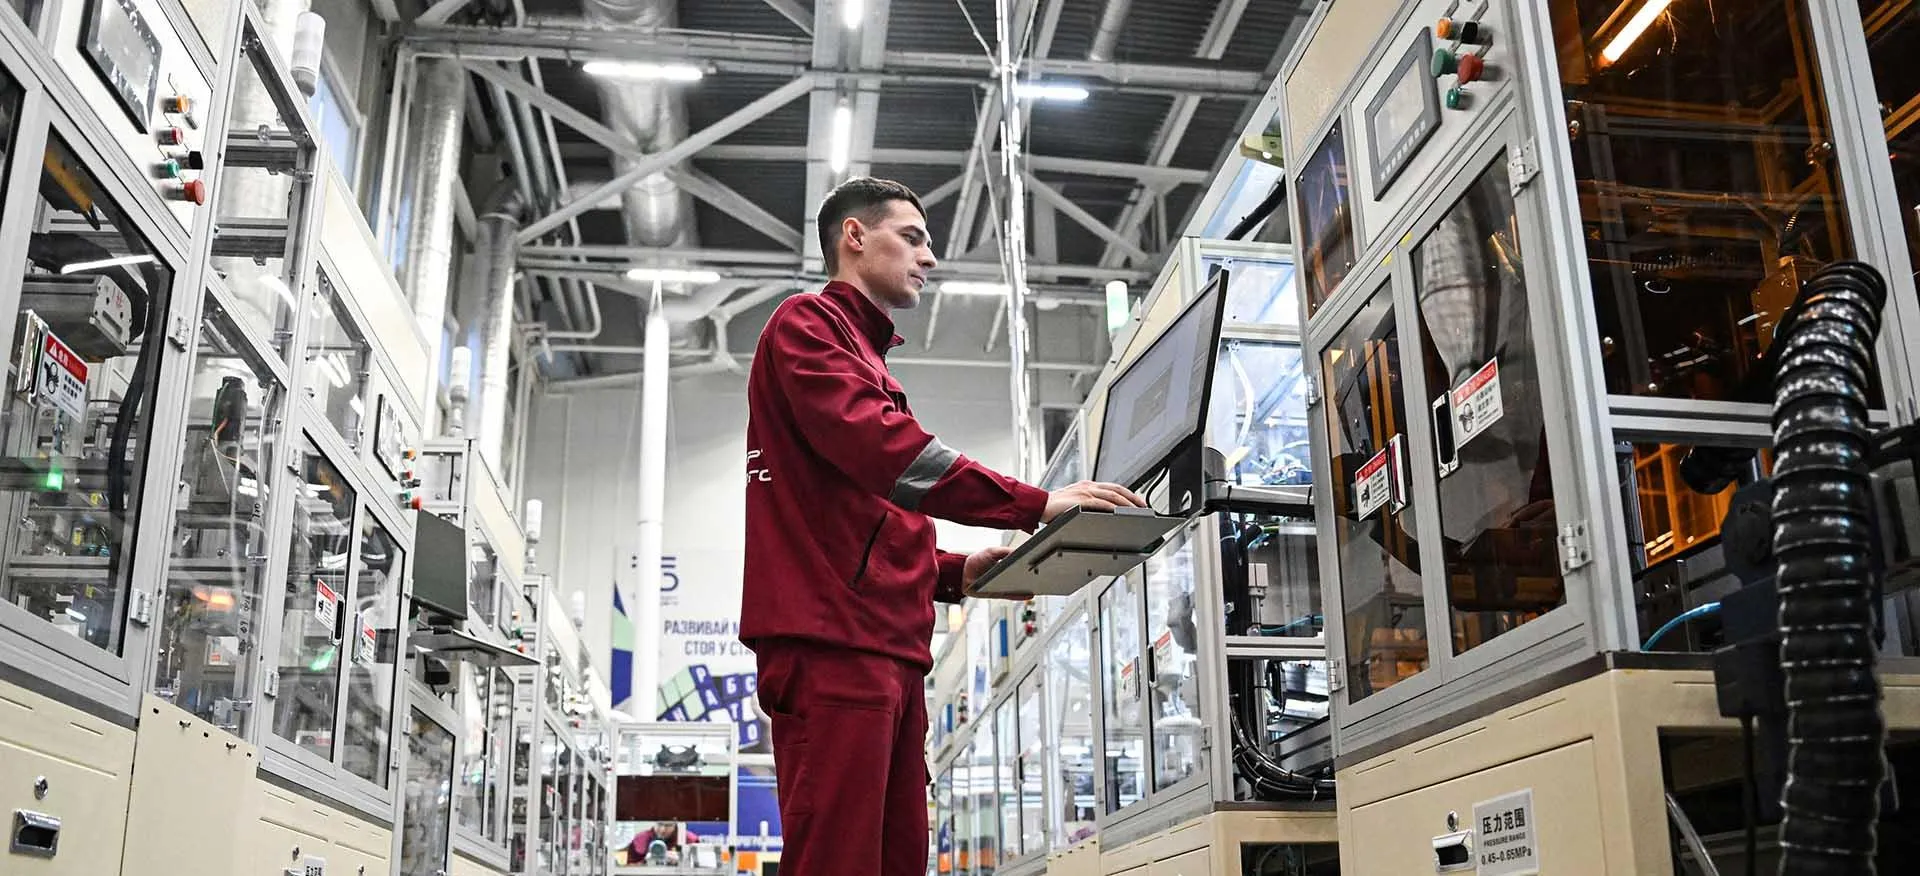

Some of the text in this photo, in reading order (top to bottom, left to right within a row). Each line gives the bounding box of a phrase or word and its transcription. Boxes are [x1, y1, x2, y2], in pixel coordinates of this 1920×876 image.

[664, 618, 729, 635] РАЗВИВАЙ
[684, 640, 716, 656] СТОЯ
[719, 641, 727, 656] У
[1482, 807, 1526, 835] 压力范围
